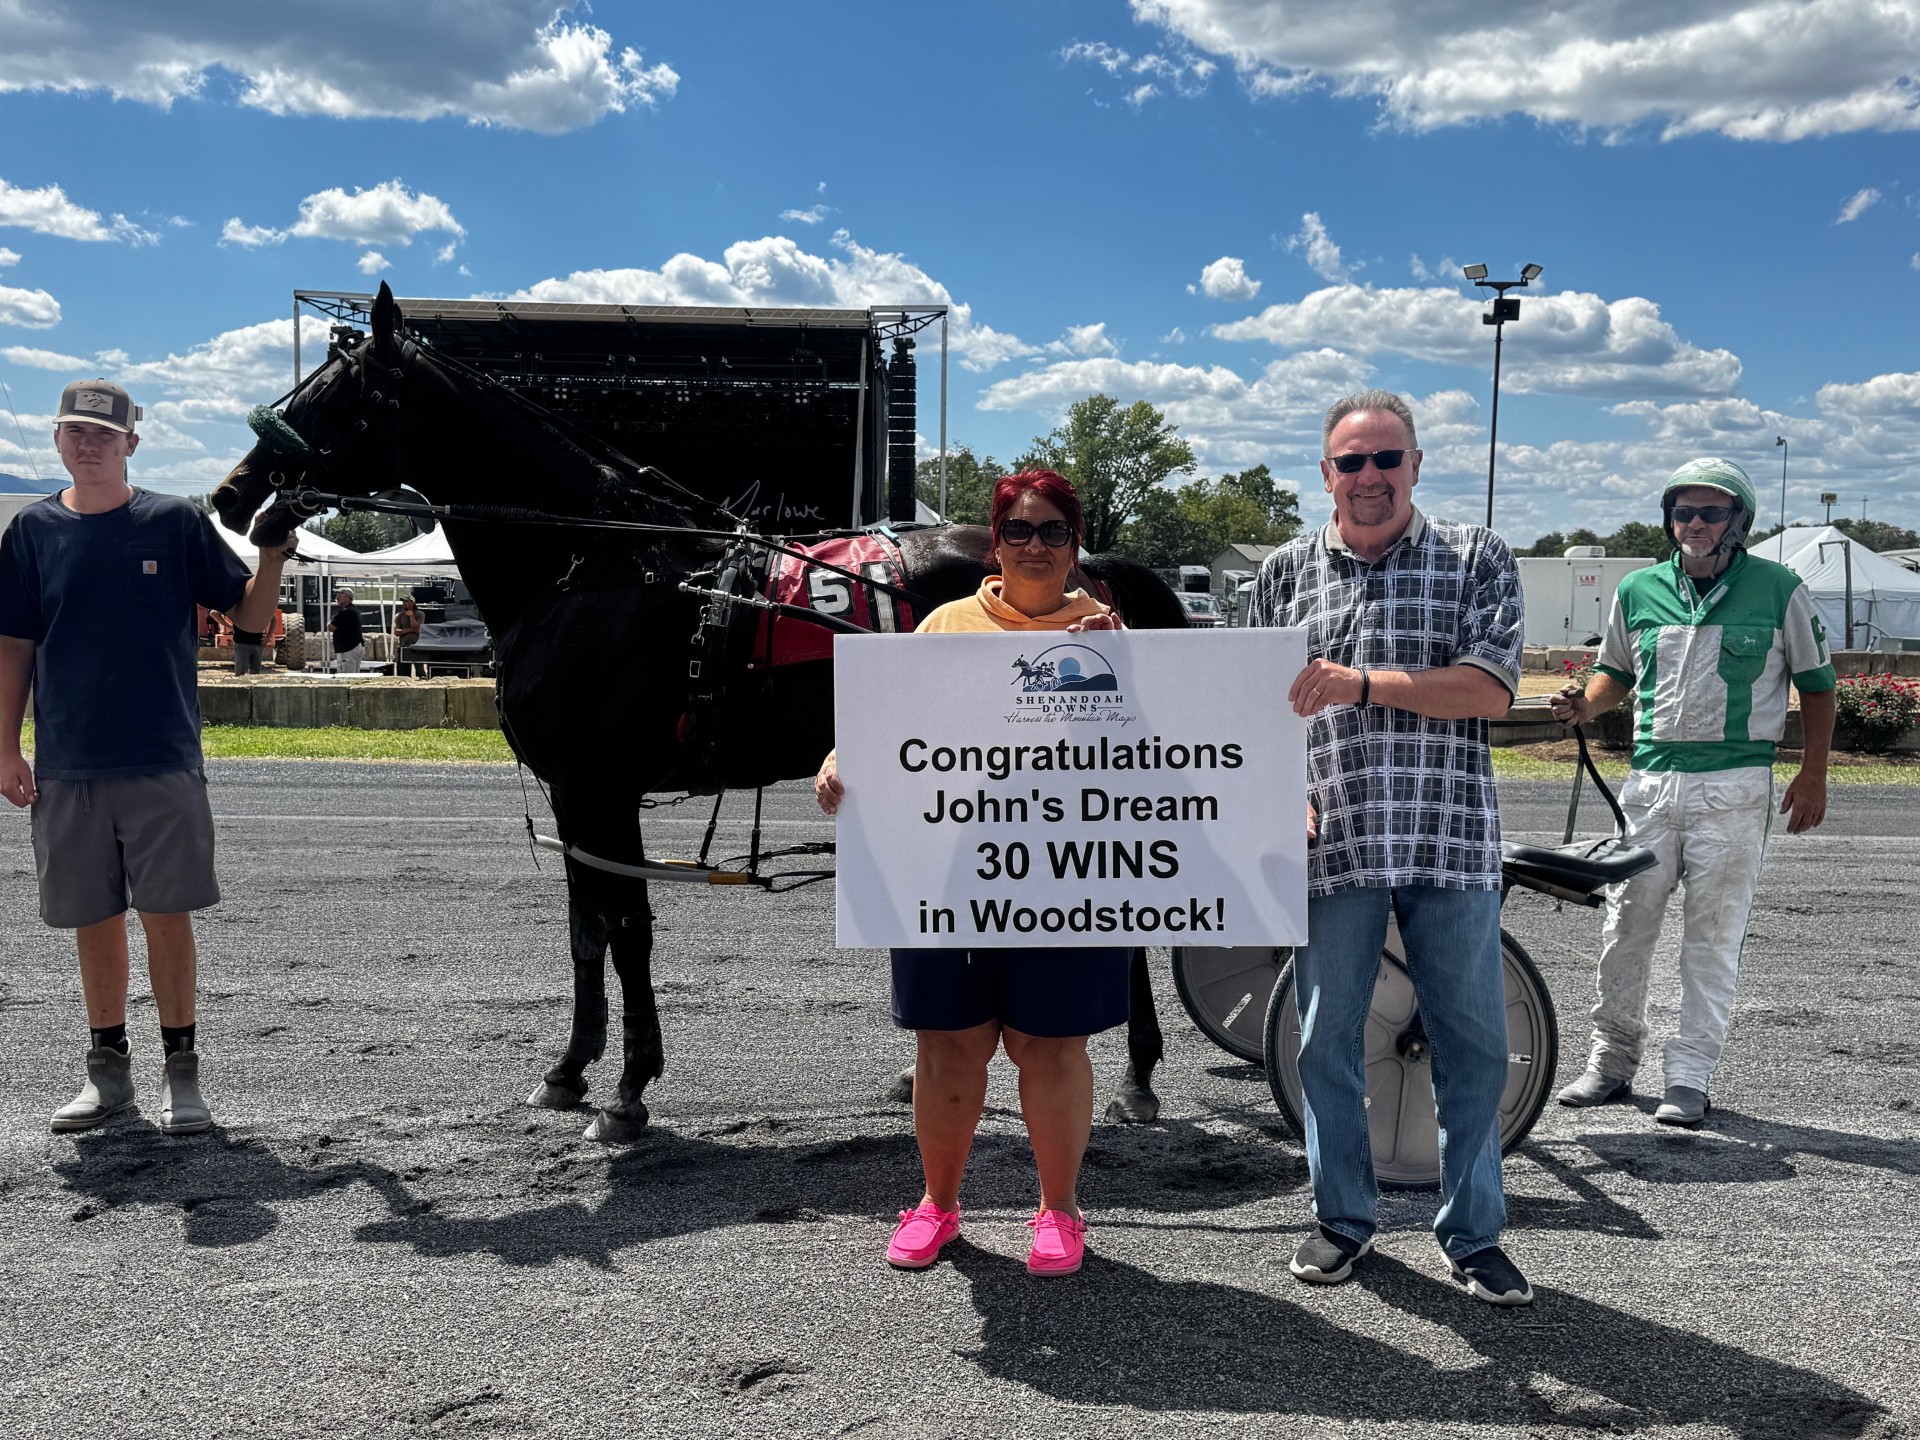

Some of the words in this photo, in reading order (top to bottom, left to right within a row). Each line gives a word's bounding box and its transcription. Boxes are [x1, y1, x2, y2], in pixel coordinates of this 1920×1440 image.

[809, 569, 850, 614] 5
[1003, 710, 1043, 724] Harness
[1043, 712, 1057, 723] the
[1059, 709, 1102, 723] Mountain
[1016, 695, 1124, 705] SHENANDOAH
[1042, 704, 1098, 713] DOWNS
[900, 736, 1244, 780] Congratulations
[924, 789, 1064, 824] John's
[1082, 789, 1218, 822] Dream
[976, 842, 1030, 880] 30
[1047, 840, 1179, 880] WINS
[919, 900, 955, 934] in
[970, 898, 1225, 933] Woodstock!
